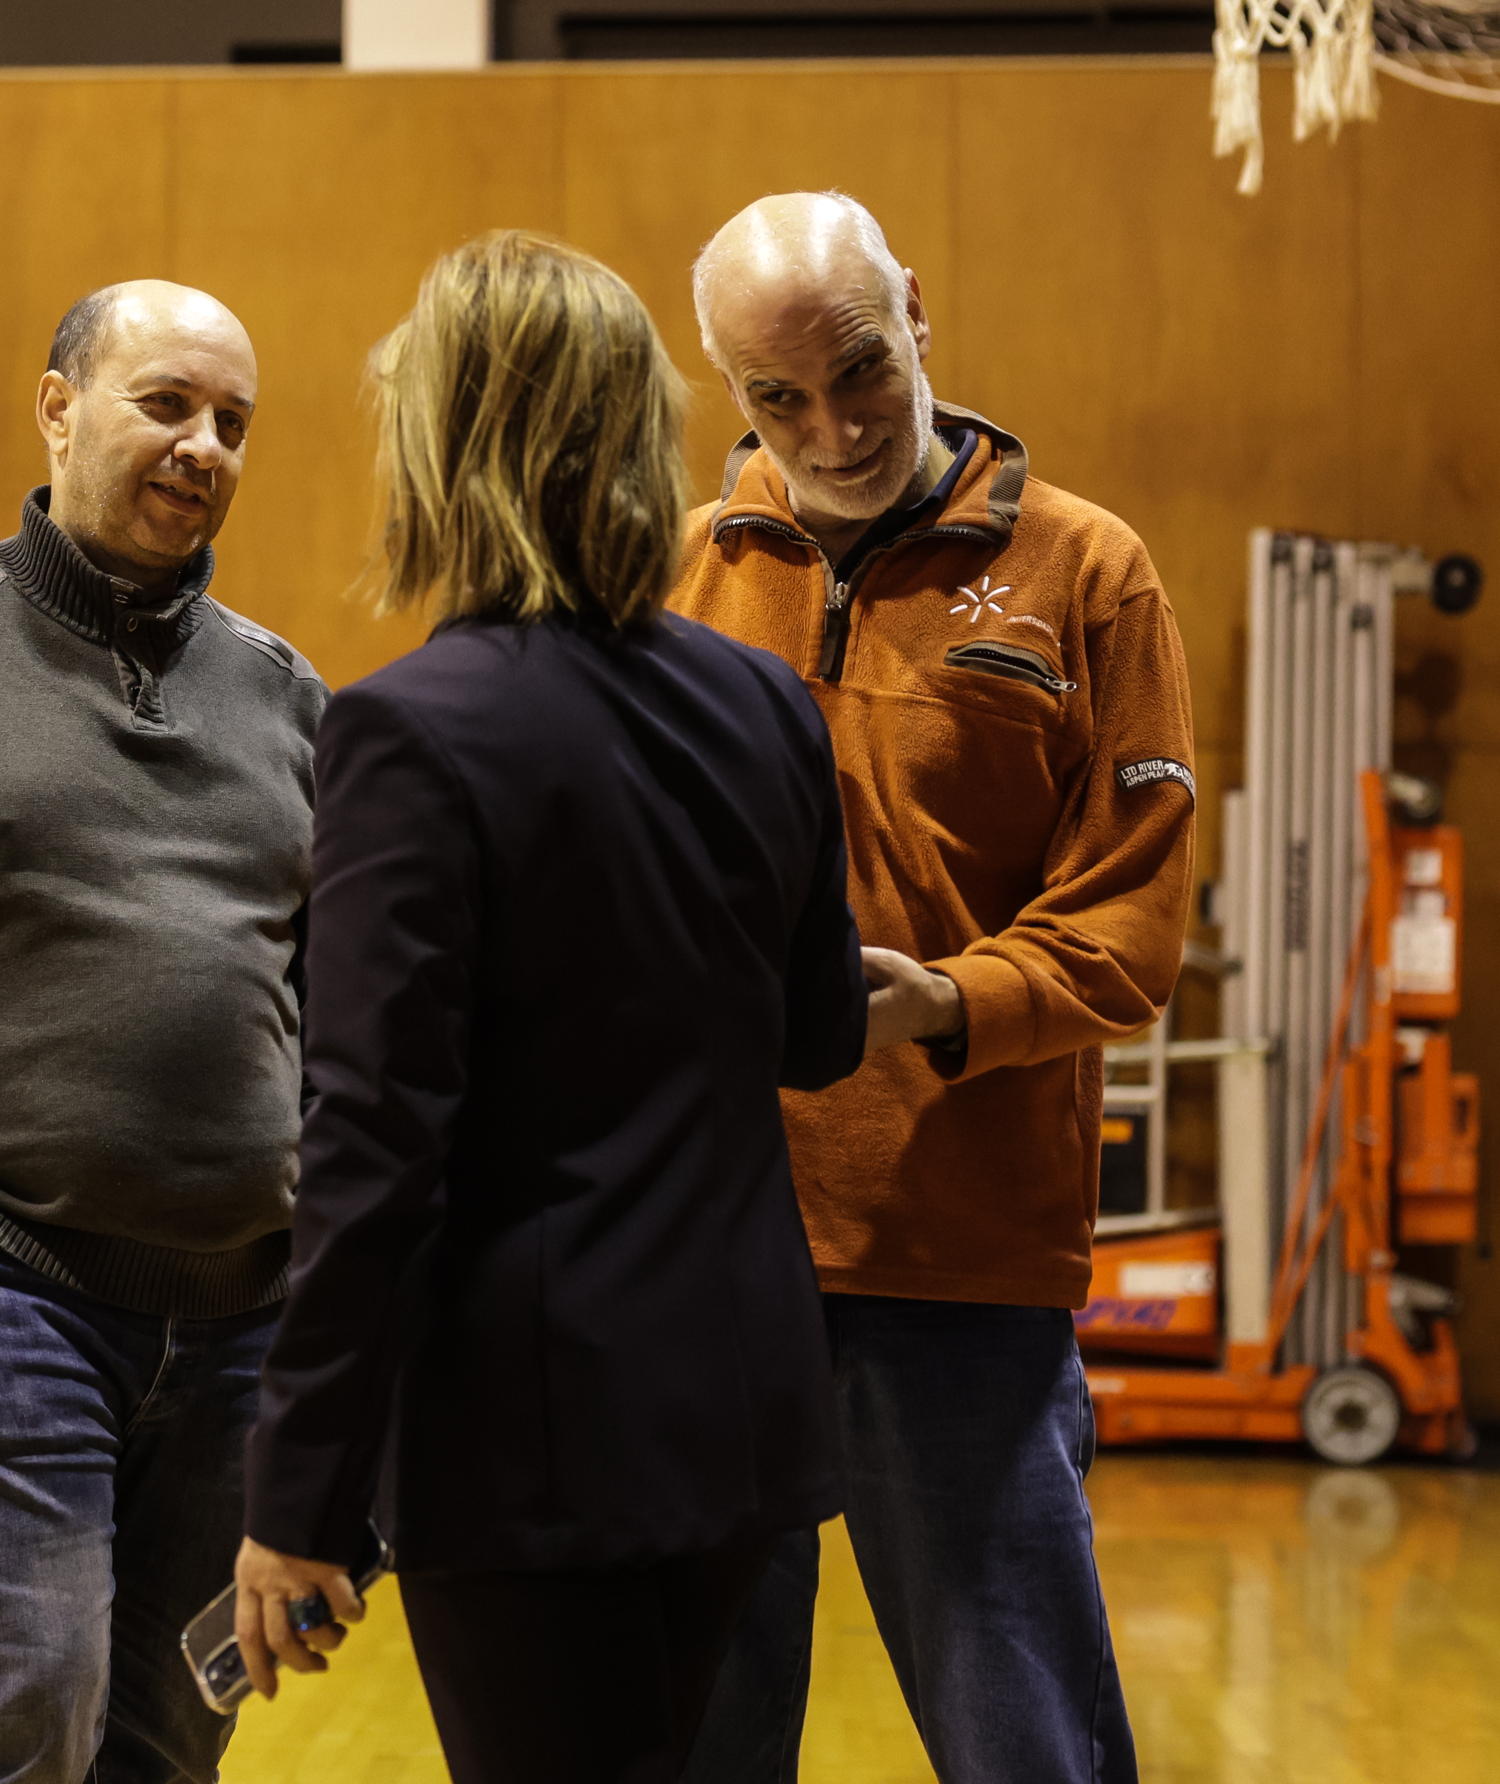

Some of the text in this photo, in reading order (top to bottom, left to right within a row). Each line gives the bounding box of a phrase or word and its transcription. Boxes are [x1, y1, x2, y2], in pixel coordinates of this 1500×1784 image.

[1120, 760, 1164, 779] LTD RIVER
[1126, 769, 1166, 787] ASPEN PEAK
